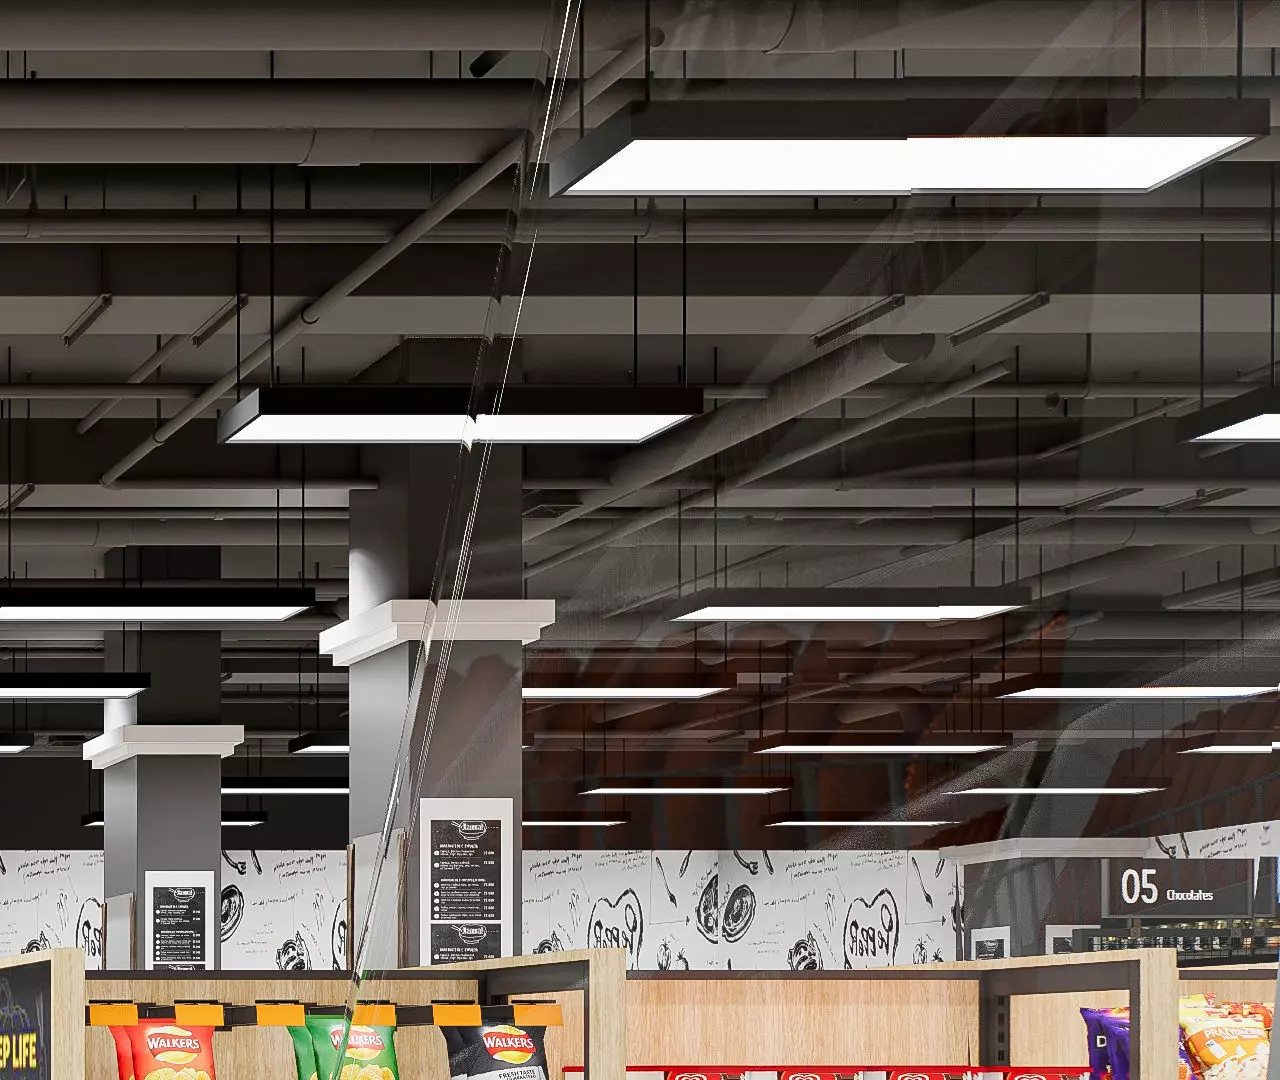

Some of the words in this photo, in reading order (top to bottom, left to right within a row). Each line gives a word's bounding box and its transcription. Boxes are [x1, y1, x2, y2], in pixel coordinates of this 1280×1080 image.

[1121, 868, 1159, 904] 05
[1166, 889, 1214, 901] Chocolates
[148, 1036, 200, 1050] WALKERS
[483, 1035, 534, 1049] WALKERS
[12, 1031, 37, 1069] LIFE
[498, 1071, 518, 1079] FRESH
